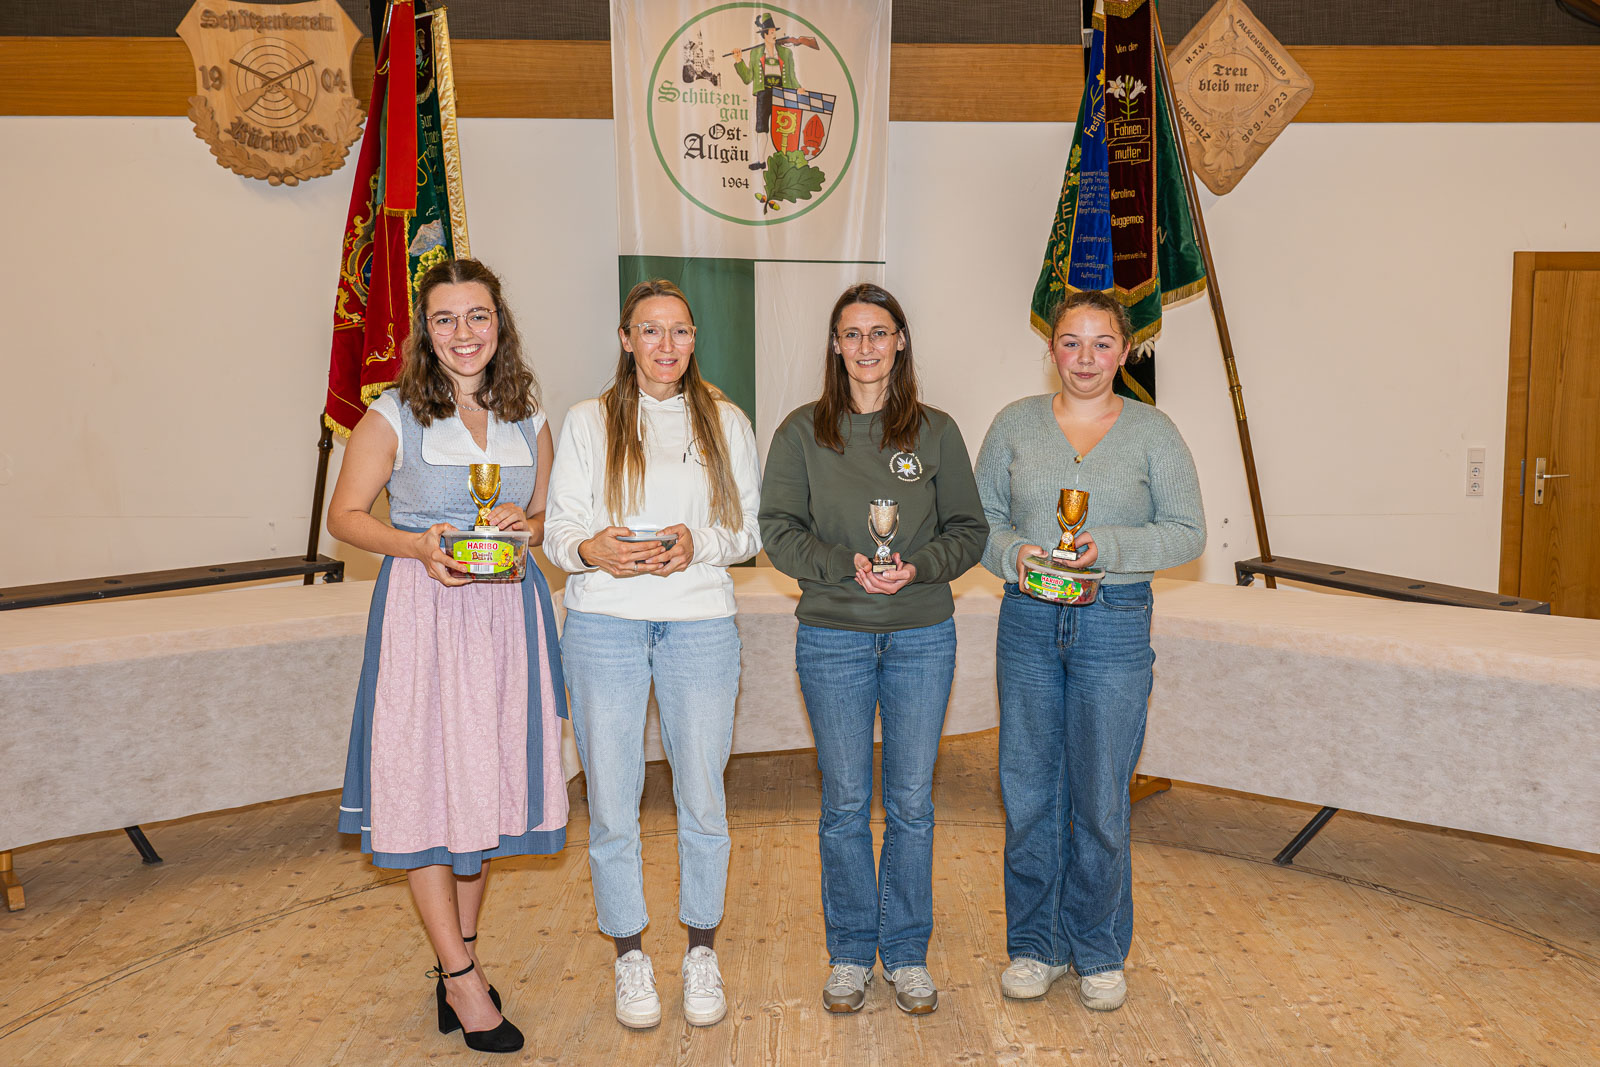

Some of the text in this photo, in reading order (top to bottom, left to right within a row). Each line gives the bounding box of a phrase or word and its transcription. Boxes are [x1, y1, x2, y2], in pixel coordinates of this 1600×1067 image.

[1115, 42, 1139, 54] Von der
[1185, 42, 1208, 64] H.T.V.
[1236, 19, 1287, 77] FALKENSBERGLER
[1212, 63, 1248, 77] Treu
[198, 65, 223, 91] 19
[320, 68, 347, 93] 04
[1198, 79, 1259, 92] bleib mer
[658, 80, 748, 108] Schützen-
[720, 107, 749, 122] gau
[1176, 99, 1212, 142] ÜCKHOLZ
[1241, 92, 1288, 143] geg. 1923
[709, 123, 748, 141] Ost-
[1113, 122, 1146, 137] Fahnen-
[683, 133, 749, 163] Allgäu
[1114, 147, 1142, 161] mutter
[722, 176, 749, 189] 1964
[1111, 188, 1136, 200] Karolina
[1110, 214, 1144, 229] Guggemos
[467, 542, 498, 550] HARIBO
[1041, 575, 1064, 586] HARIBO
